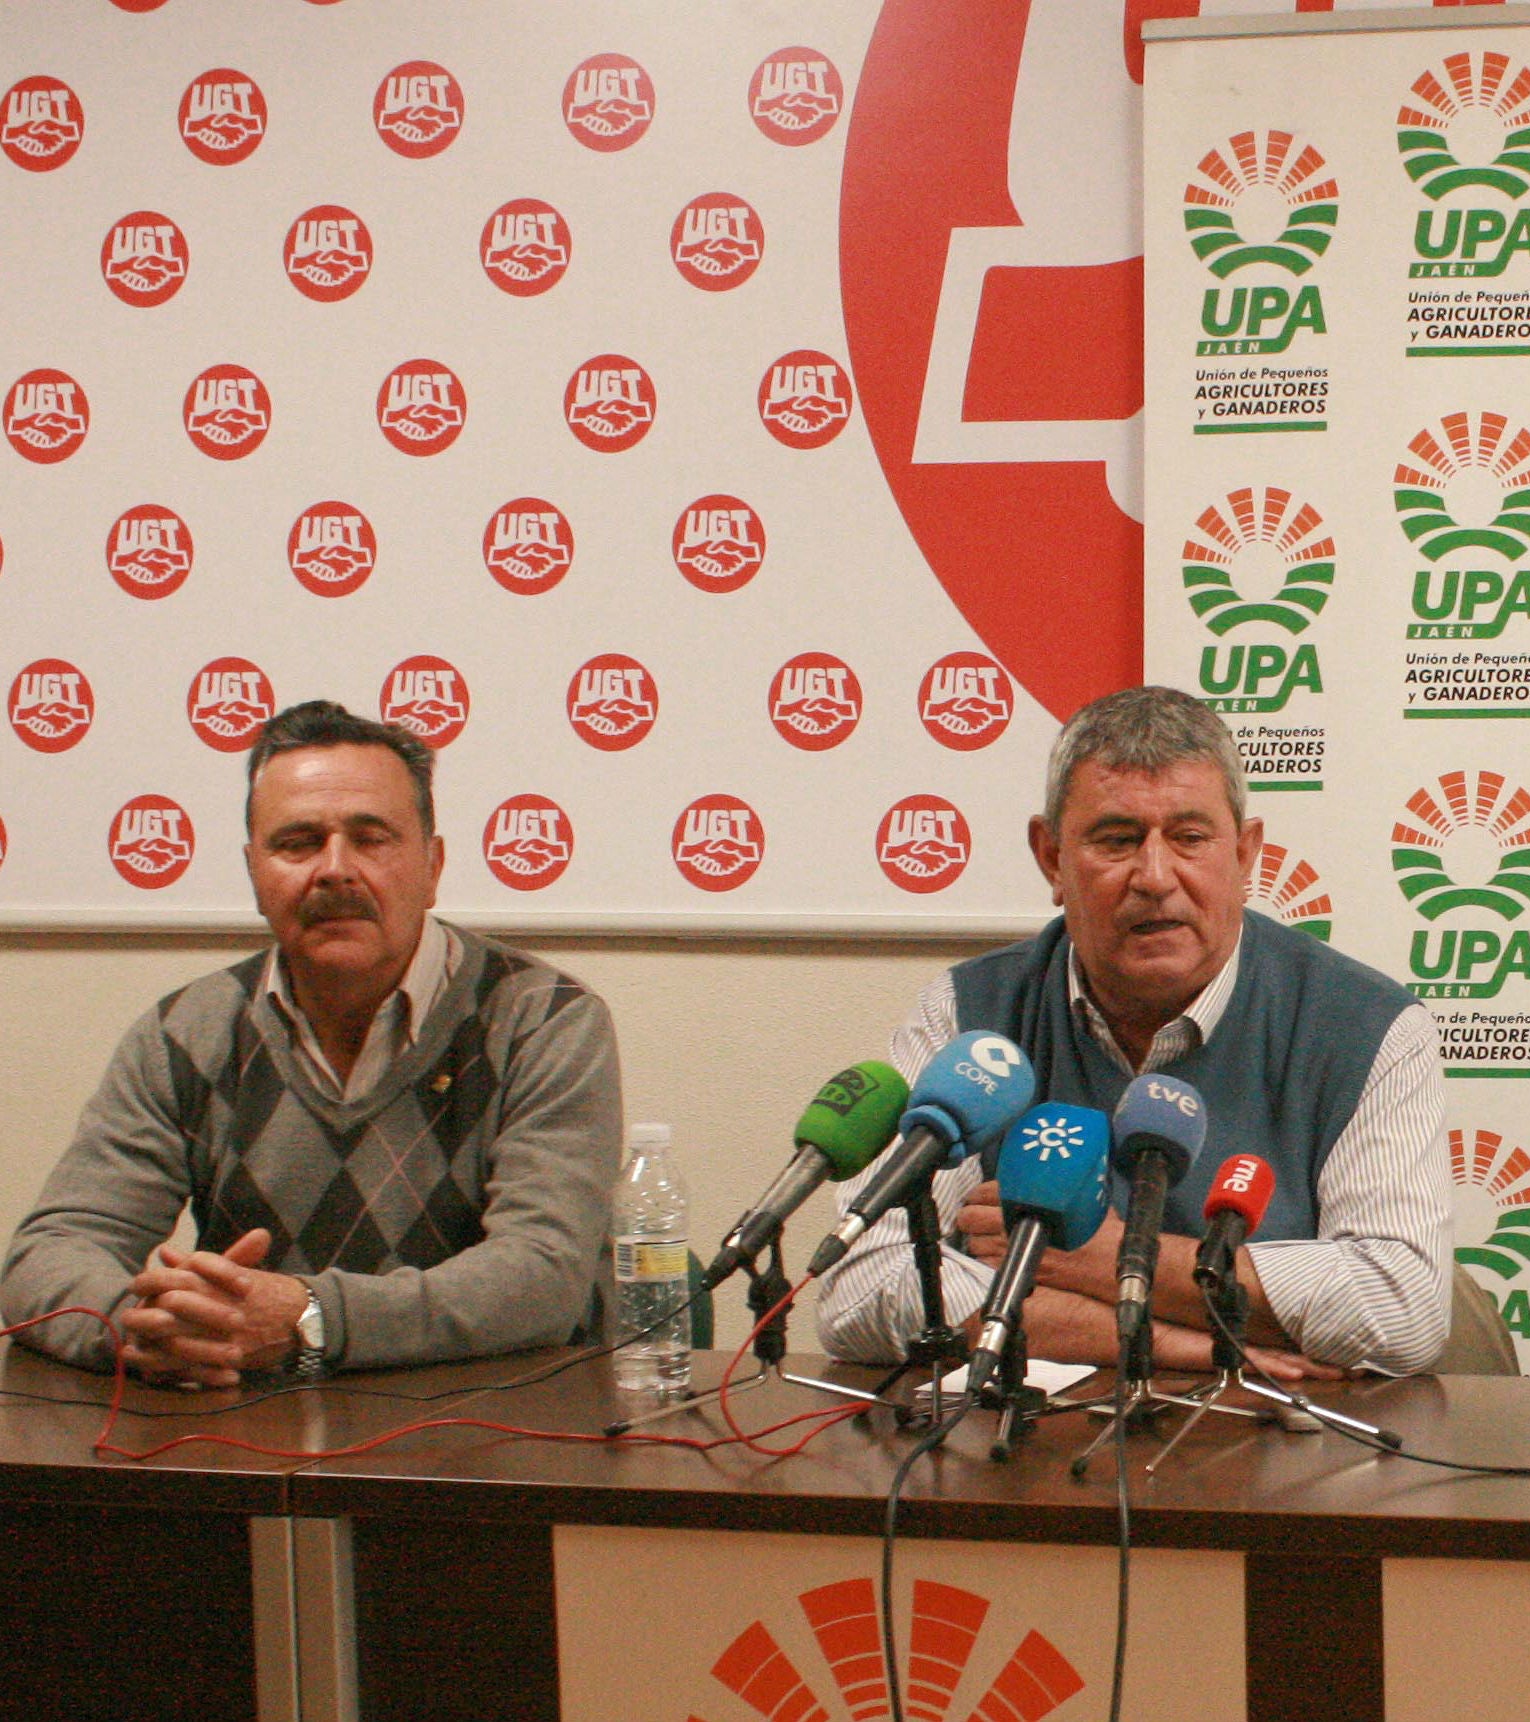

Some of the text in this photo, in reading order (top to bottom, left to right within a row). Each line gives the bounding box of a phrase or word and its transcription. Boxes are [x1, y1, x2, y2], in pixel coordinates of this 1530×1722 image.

[385, 75, 452, 108] UGT
[574, 69, 642, 102] UGT
[761, 63, 830, 96] UGT
[6, 90, 72, 123] UGT
[189, 83, 255, 116] UGT
[295, 219, 362, 252] UGT
[492, 213, 559, 246] UGT
[682, 207, 751, 240] UGT
[112, 226, 178, 258] UGT
[1201, 285, 1327, 336] UPA
[1408, 292, 1449, 303] Unión
[1454, 290, 1472, 303] de
[1410, 330, 1418, 342] y
[576, 369, 644, 402] UGT
[769, 364, 838, 398] UGT
[1195, 366, 1328, 381] Unión de Pequeños
[13, 383, 78, 415] UGT
[195, 379, 260, 411] UGT
[388, 374, 454, 407] UGT
[1195, 382, 1329, 399] AGRICULTORES
[1197, 400, 1326, 420] y GANADEROS
[117, 518, 182, 551] UGT
[298, 515, 365, 548] UGT
[494, 512, 561, 545] UGT
[684, 509, 753, 542] UGT
[1199, 643, 1323, 694] UPA
[1406, 654, 1447, 665] Unión
[1452, 652, 1470, 665] de
[19, 672, 83, 705] UGT
[198, 672, 263, 704] UGT
[391, 670, 458, 702] UGT
[578, 668, 645, 701] UGT
[780, 667, 850, 700] UGT
[929, 666, 999, 700] UGT
[1408, 692, 1416, 704] y
[1237, 725, 1325, 740] de Pequeños
[1237, 742, 1325, 757] CULTORES
[119, 808, 183, 841] UGT
[494, 808, 561, 841] UGT
[684, 808, 751, 842] UGT
[888, 809, 958, 842] UGT
[1449, 1011, 1467, 1024] de
[955, 1061, 999, 1096] COPE
[1147, 1081, 1199, 1118] tve
[1223, 1159, 1258, 1193] rne
